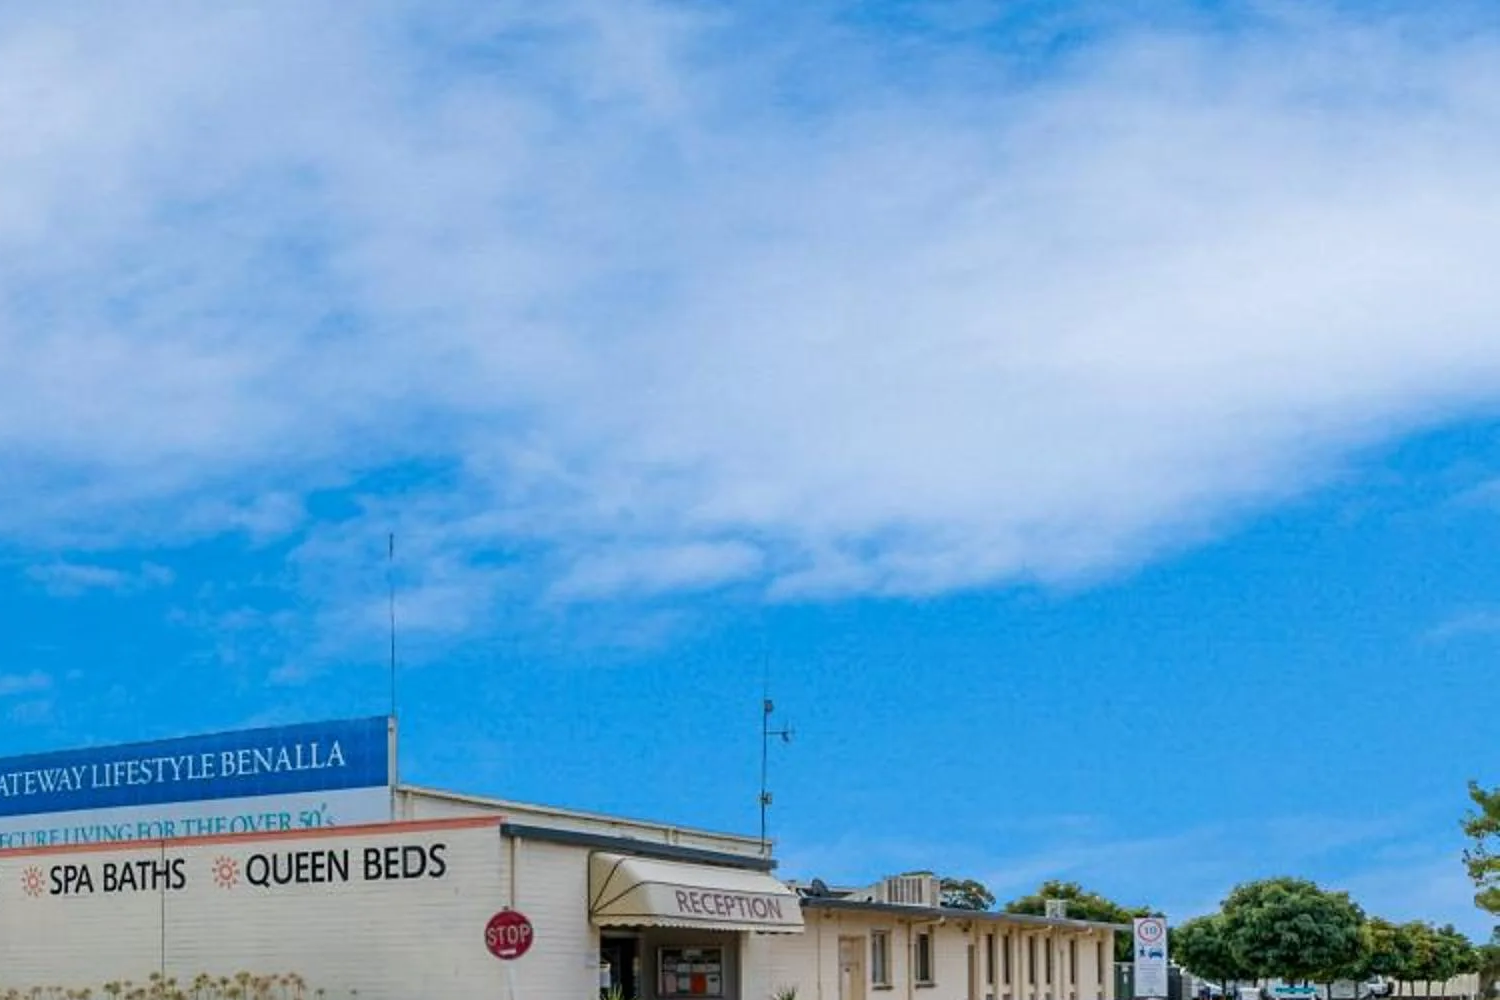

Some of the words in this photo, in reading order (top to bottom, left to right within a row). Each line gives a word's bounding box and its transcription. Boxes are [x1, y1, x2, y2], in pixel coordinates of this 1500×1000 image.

[91, 753, 215, 788] LIFESTYLE
[221, 740, 346, 777] BENALLA
[230, 811, 292, 833] OVER
[50, 864, 95, 895] SPA
[103, 858, 186, 892] BATHS
[245, 849, 349, 888] QUEEN
[363, 843, 447, 881] BEDS
[675, 889, 783, 919] RECEPTION
[487, 923, 531, 947] STOP
